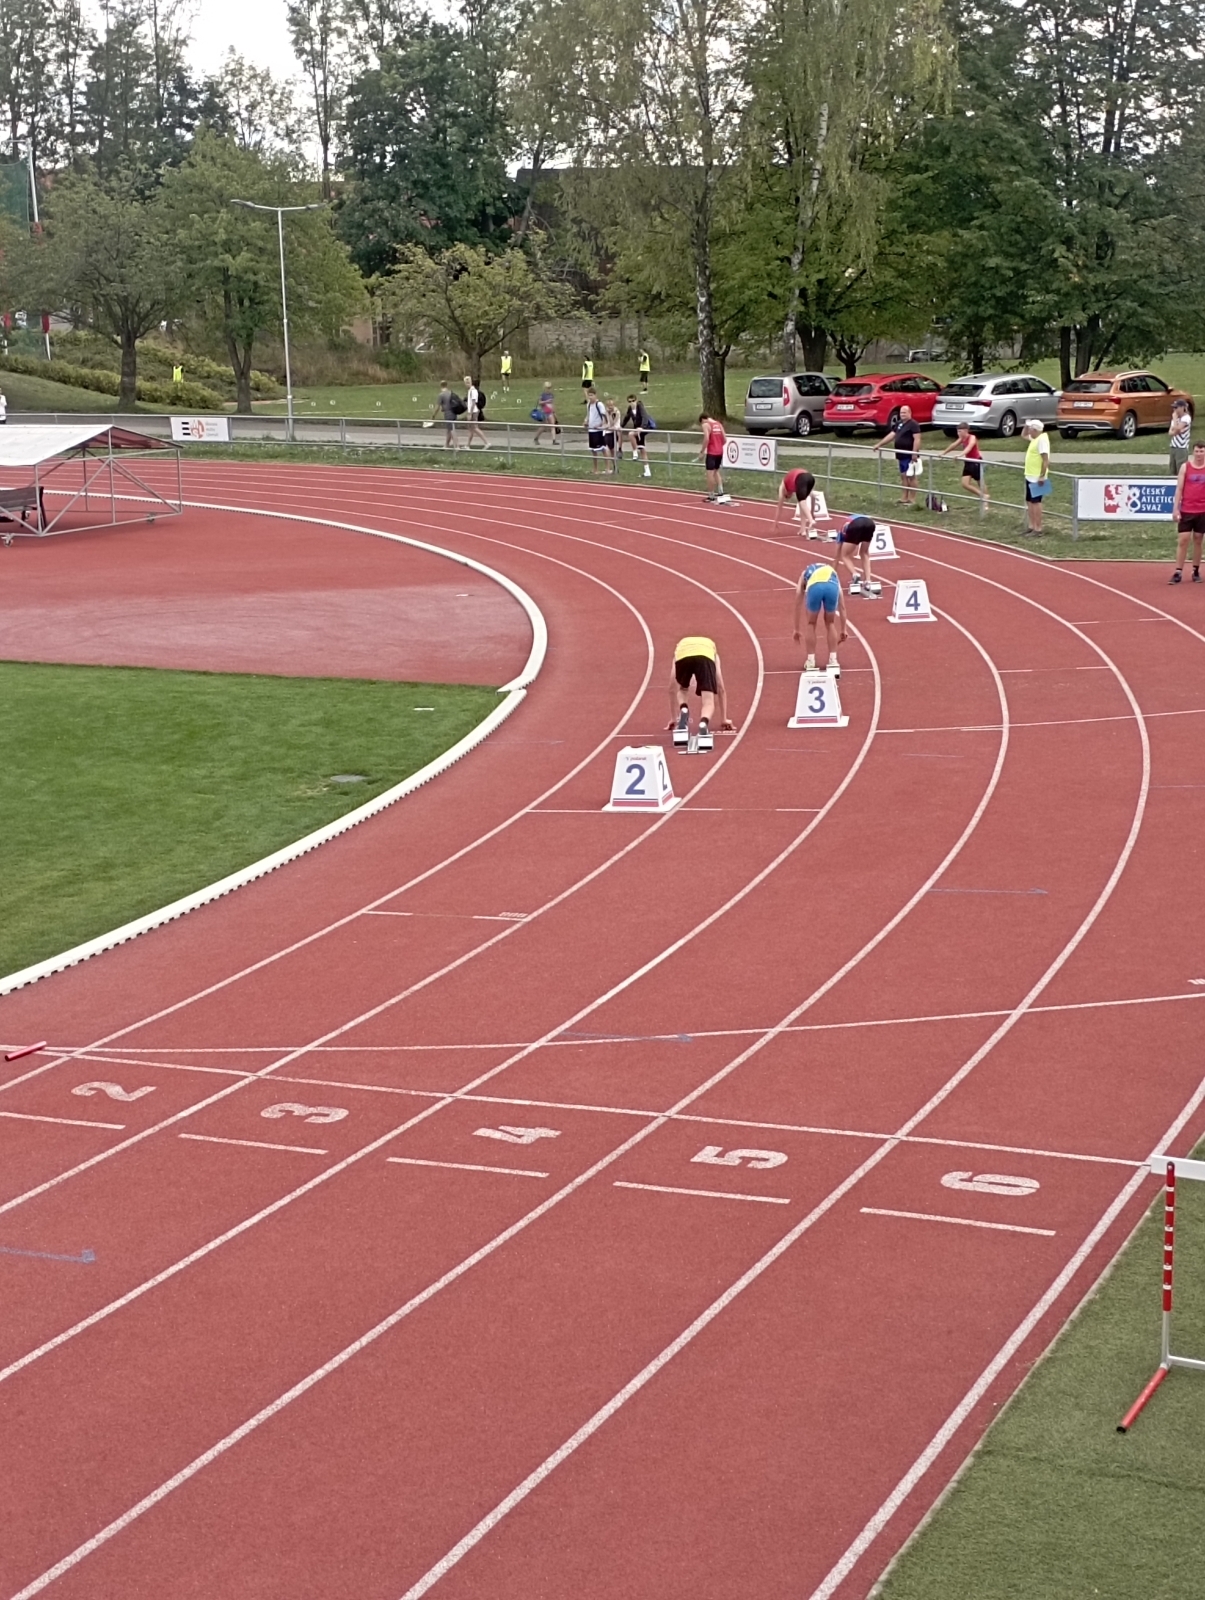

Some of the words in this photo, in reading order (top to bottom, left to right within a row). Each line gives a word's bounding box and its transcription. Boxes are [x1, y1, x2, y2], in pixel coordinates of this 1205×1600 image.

[1141, 486, 1166, 495] ČESKÝ
[813, 497, 821, 513] 6
[875, 532, 887, 551] 5
[905, 590, 921, 612] 4
[808, 686, 826, 713] 3
[625, 763, 646, 795] 2
[658, 760, 668, 791] 2
[71, 1081, 157, 1101] 2
[260, 1102, 349, 1123] 3
[471, 1125, 562, 1144] 4
[690, 1145, 788, 1169] 5
[940, 1171, 1040, 1196] 6
